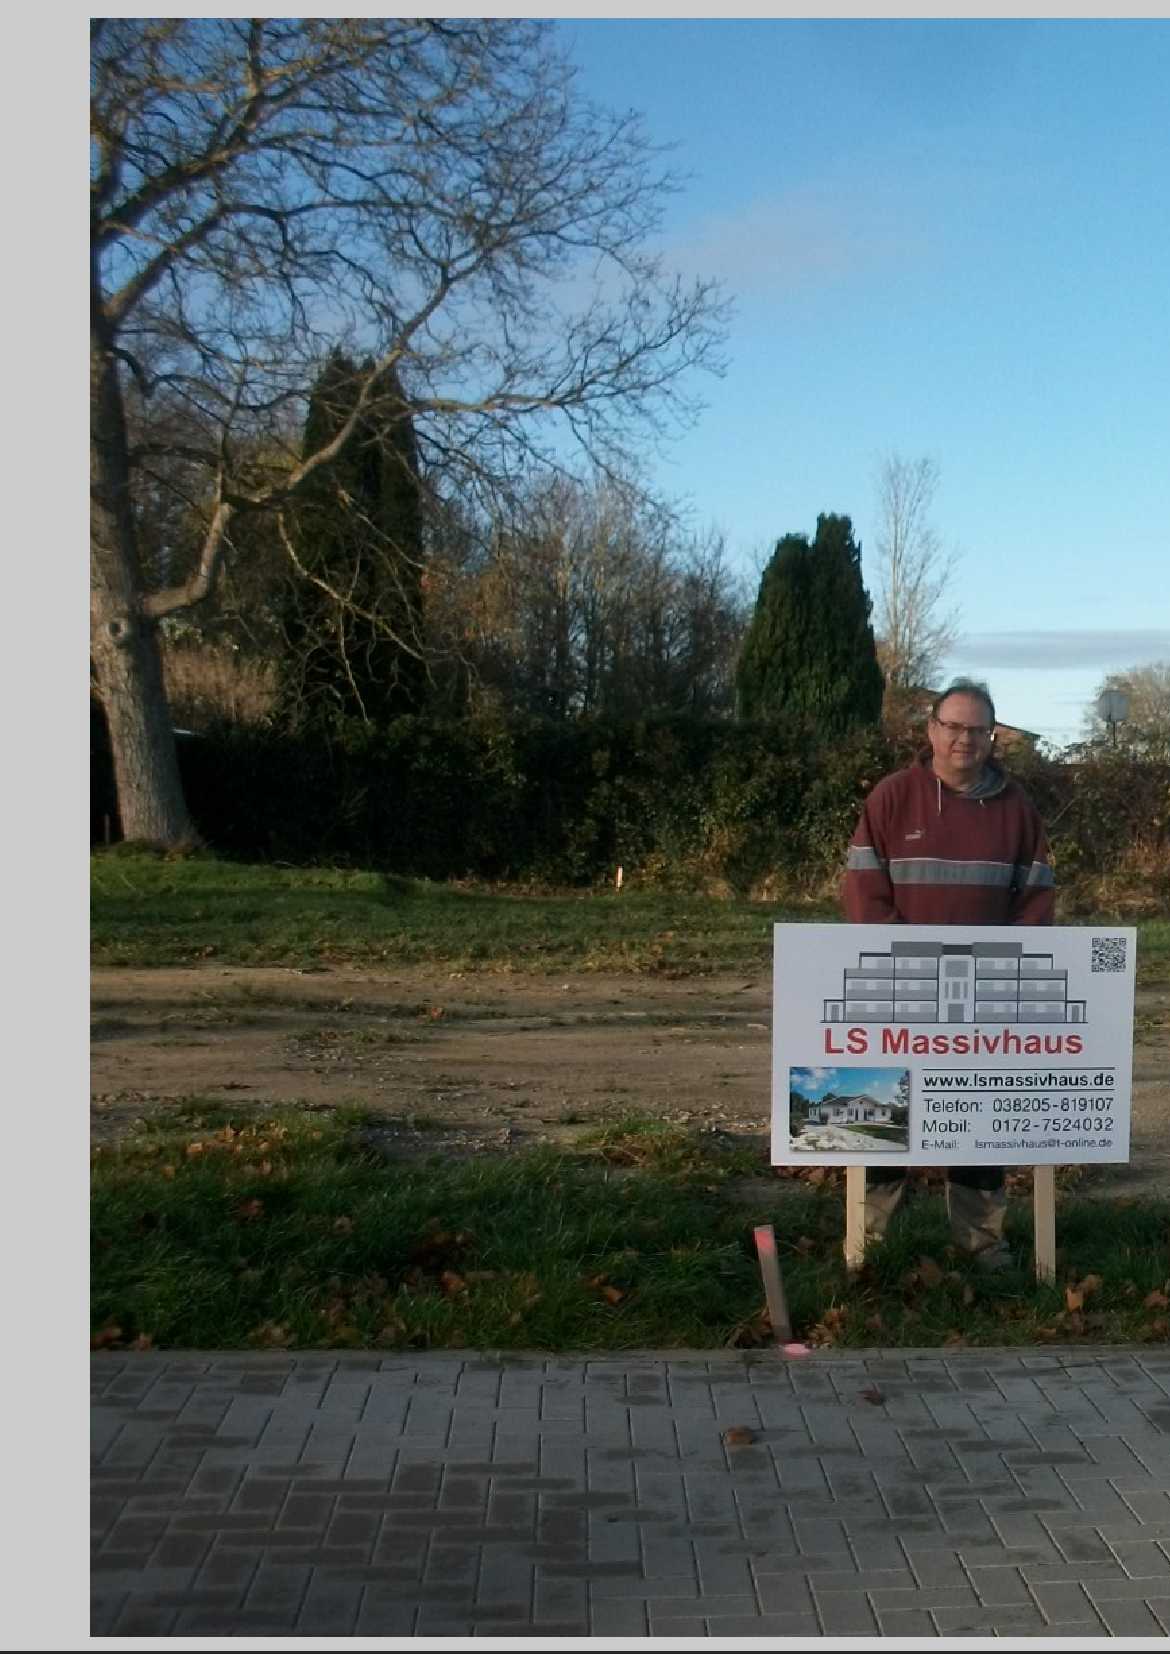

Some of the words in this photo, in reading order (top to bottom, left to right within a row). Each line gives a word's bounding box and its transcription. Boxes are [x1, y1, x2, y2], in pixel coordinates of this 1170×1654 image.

[824, 1027, 869, 1055] LS
[882, 1027, 1084, 1055] Massivhaus
[923, 1072, 1115, 1088] www.lsmassivhaus.de
[925, 1098, 984, 1114] Telefon:
[992, 1097, 1114, 1113] 038205-819107
[922, 1118, 972, 1134] Mobil:
[992, 1118, 1114, 1133] 0172-7524032
[922, 1139, 960, 1150] E-Mail:
